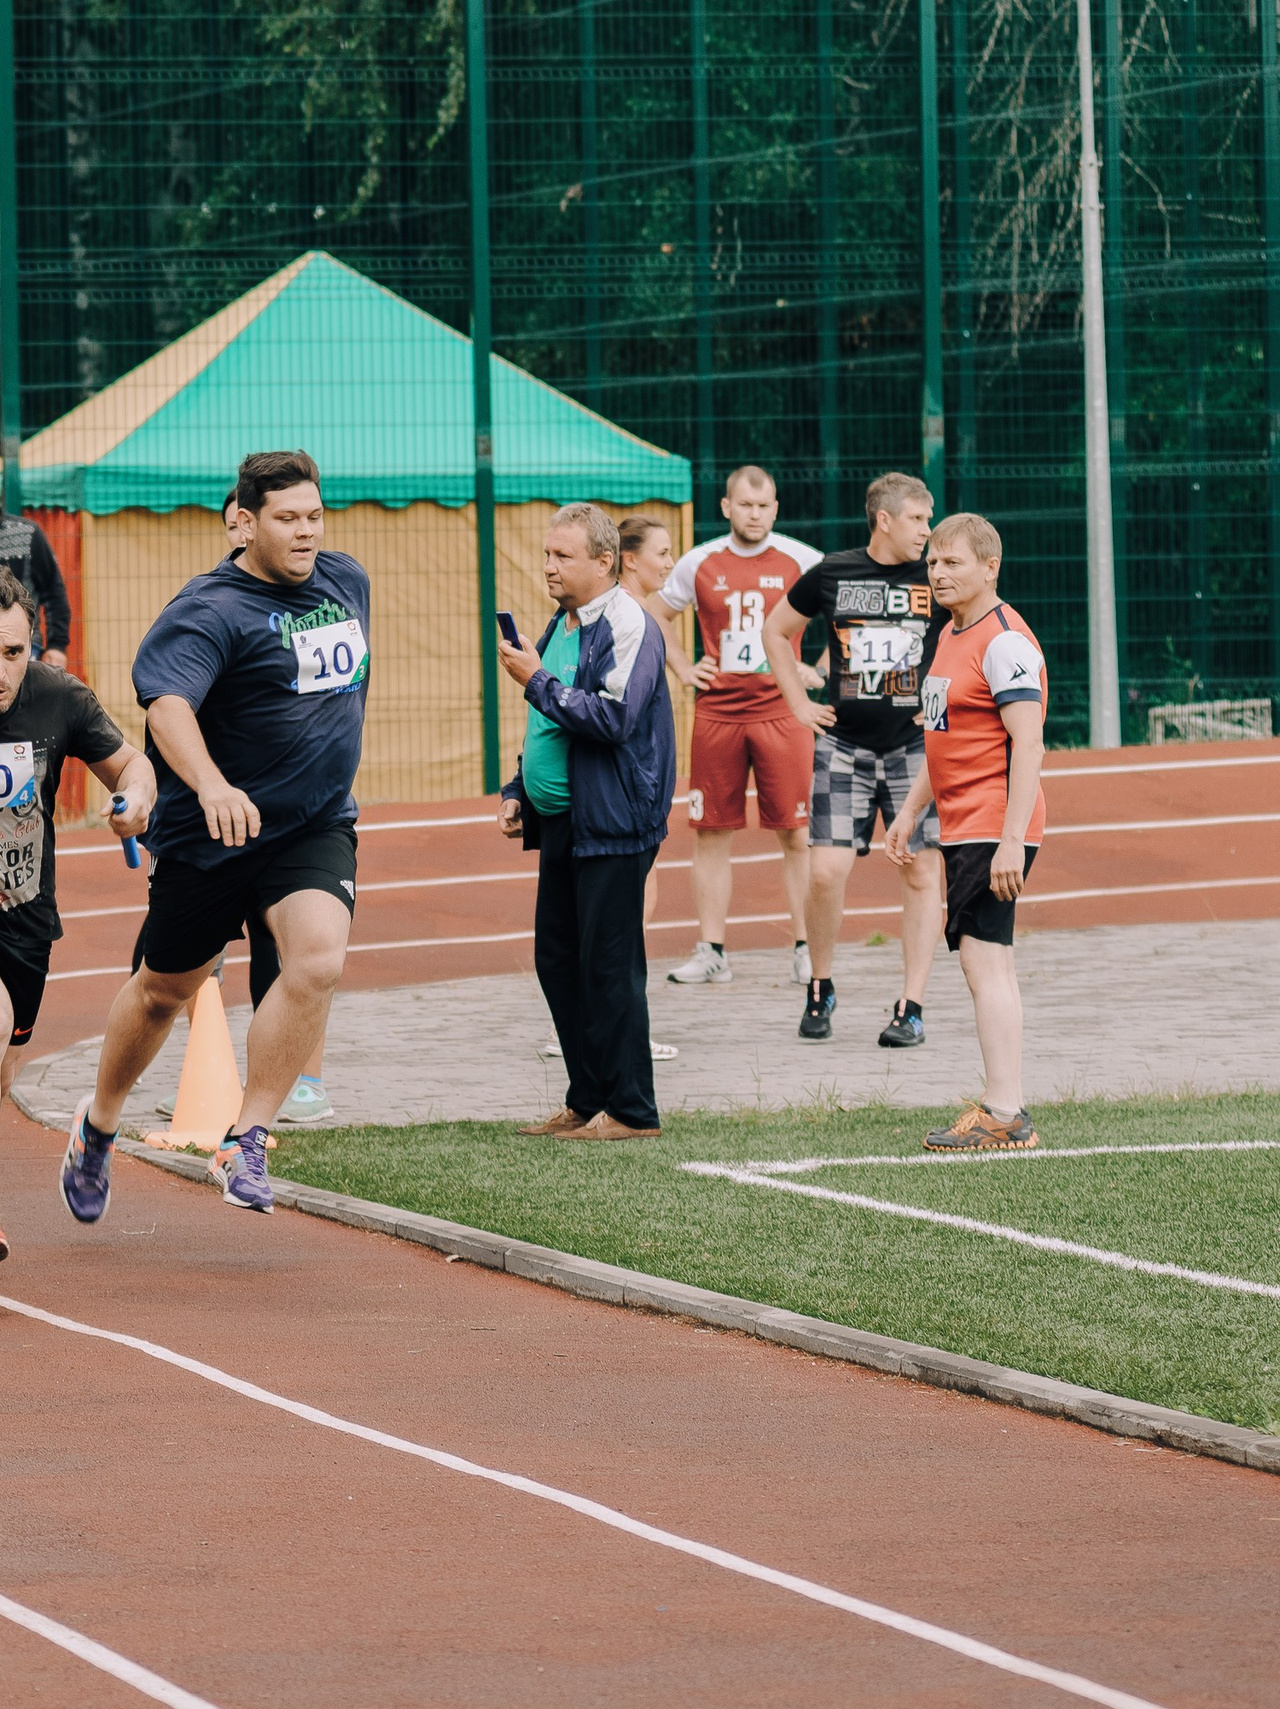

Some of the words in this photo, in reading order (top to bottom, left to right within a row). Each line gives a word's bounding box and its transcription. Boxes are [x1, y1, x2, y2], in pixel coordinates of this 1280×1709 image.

[724, 590, 764, 632] 13
[313, 641, 354, 680] 10
[737, 644, 751, 665] 4
[862, 640, 895, 663] 11
[358, 664, 365, 679] 3
[924, 692, 939, 722] 10
[20, 789, 28, 801] 4
[13, 815, 41, 839] Club
